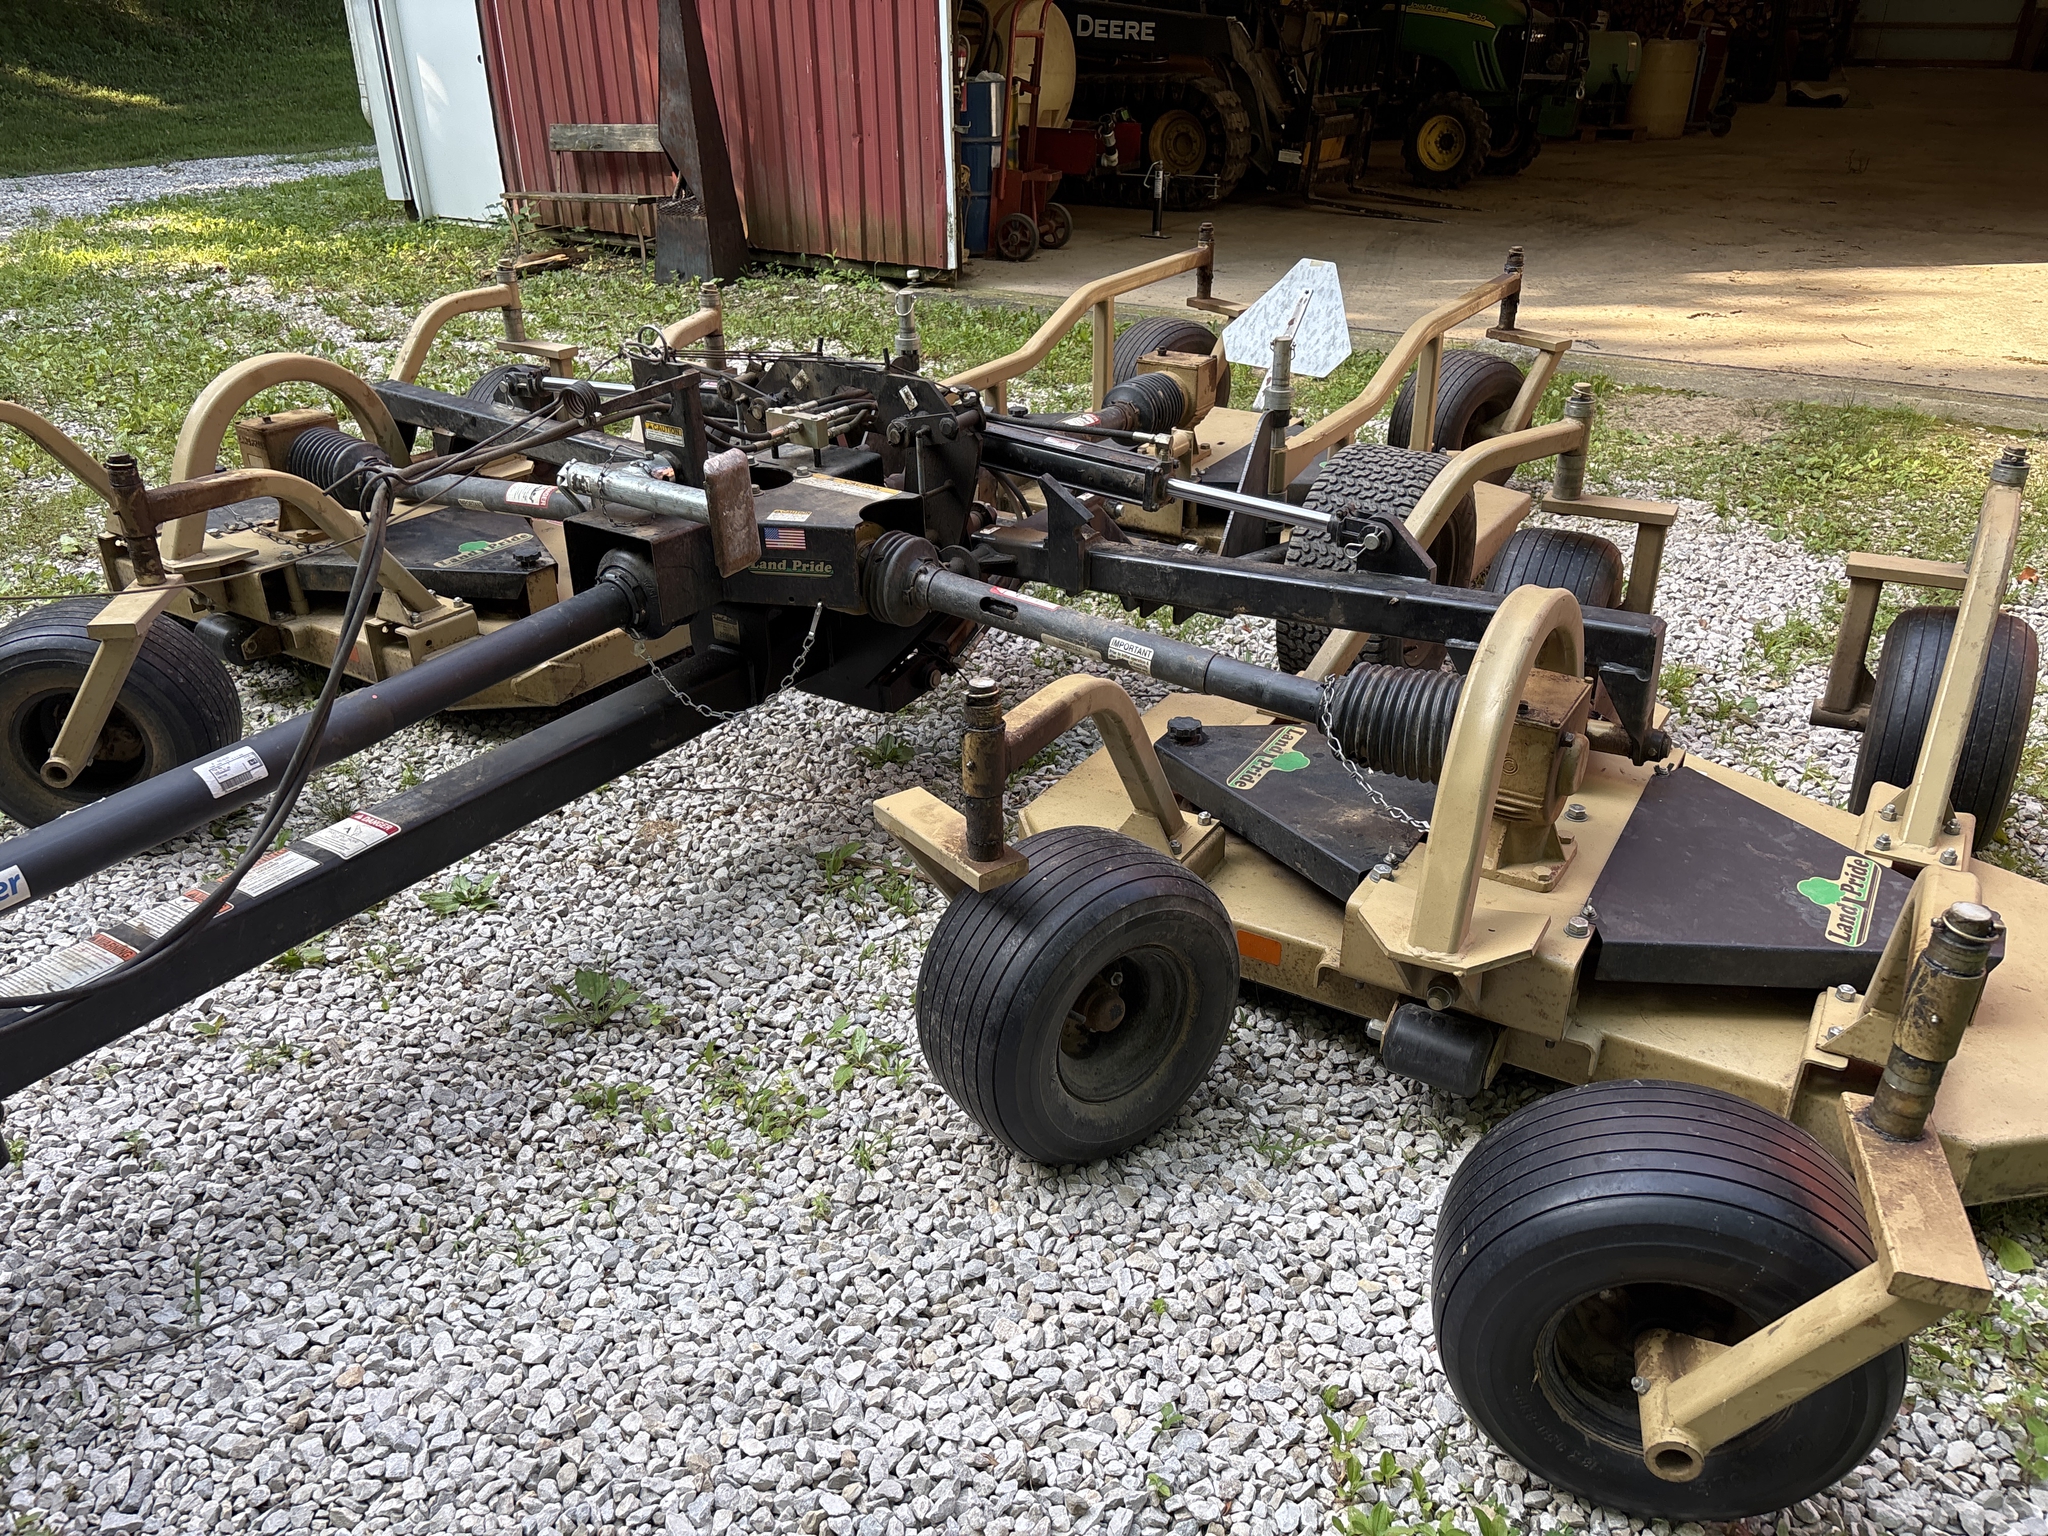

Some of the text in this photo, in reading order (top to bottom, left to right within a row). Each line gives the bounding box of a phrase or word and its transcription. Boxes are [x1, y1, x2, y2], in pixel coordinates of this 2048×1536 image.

[1426, 4, 1449, 13] DEERE
[1076, 14, 1156, 41] DEERE
[438, 533, 529, 566] Land Pride
[750, 559, 833, 573] Land Pride
[1111, 639, 1153, 659] IMPORTANT
[1234, 728, 1304, 788] Land Pride
[361, 815, 394, 831] DANGER
[1827, 858, 1870, 943] Land Pride
[95, 935, 134, 959] WARNING
